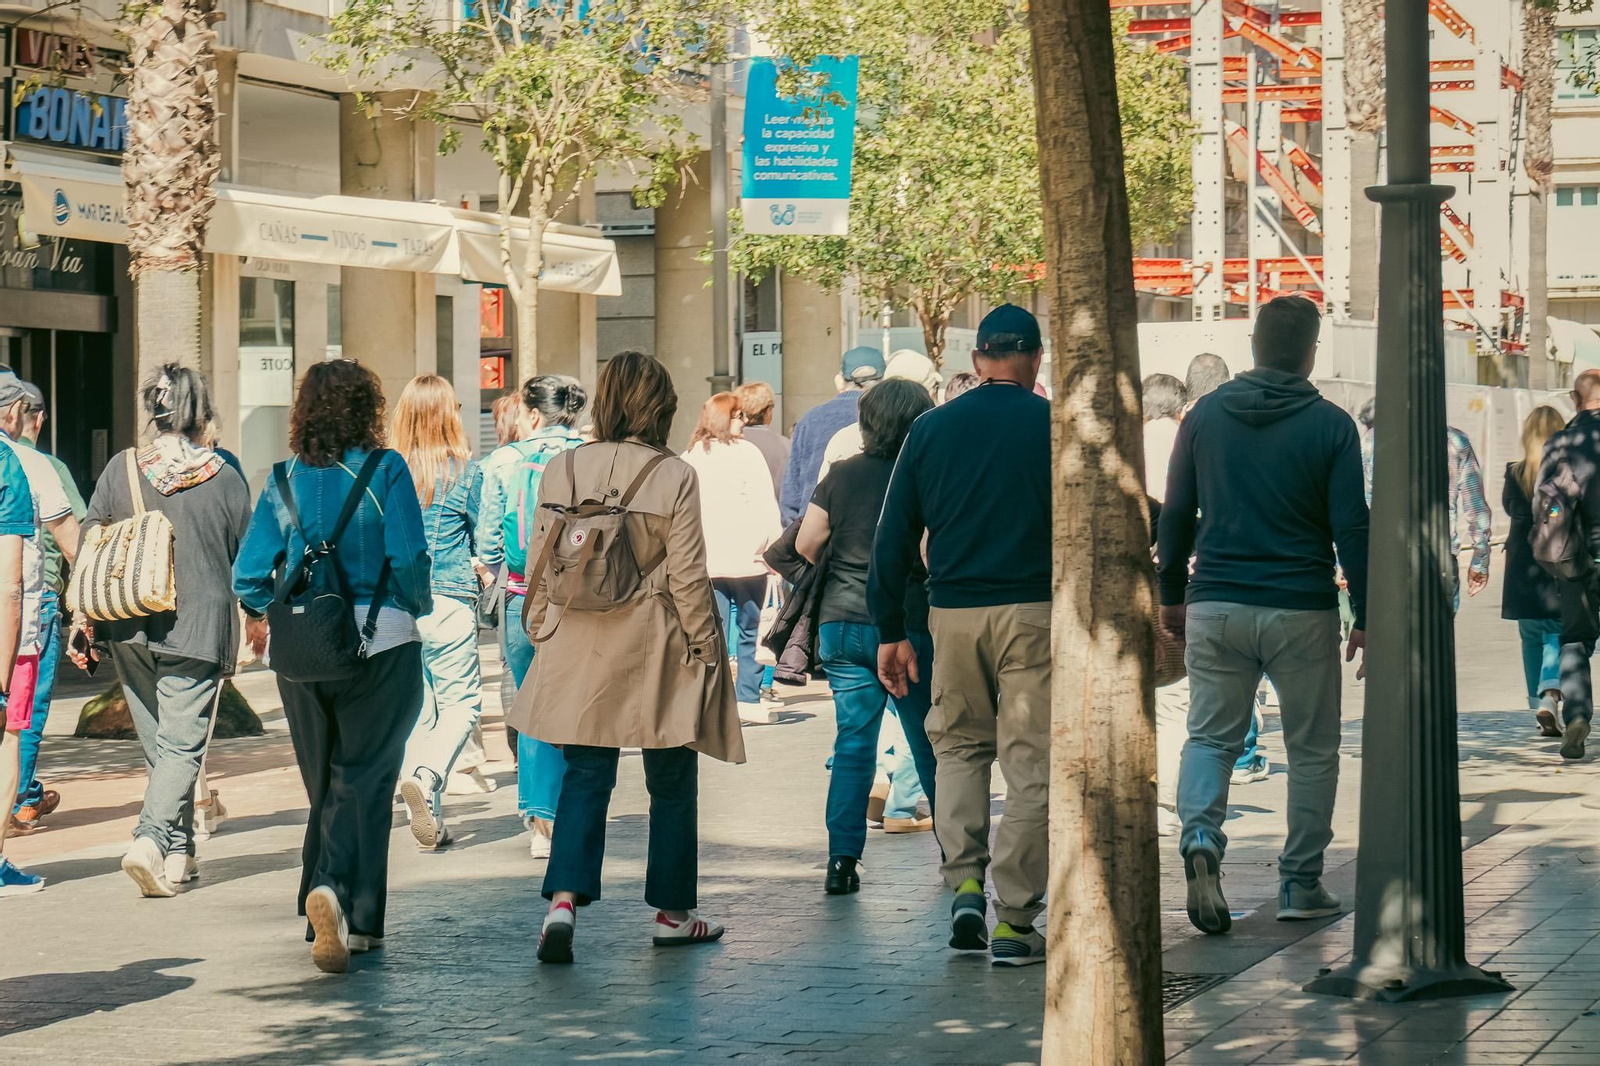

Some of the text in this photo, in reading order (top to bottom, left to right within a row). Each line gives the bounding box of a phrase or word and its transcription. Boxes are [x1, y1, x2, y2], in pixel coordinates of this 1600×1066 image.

[765, 114, 791, 125] Leer
[761, 128, 835, 141] la capacidad
[764, 142, 831, 155] expresiva y
[754, 156, 839, 167] las habilidades
[753, 169, 839, 181] comunicativas.
[259, 220, 298, 245] CAÑAS
[332, 229, 366, 251] VINOS
[0, 249, 40, 270] ran
[752, 343, 766, 356] EL
